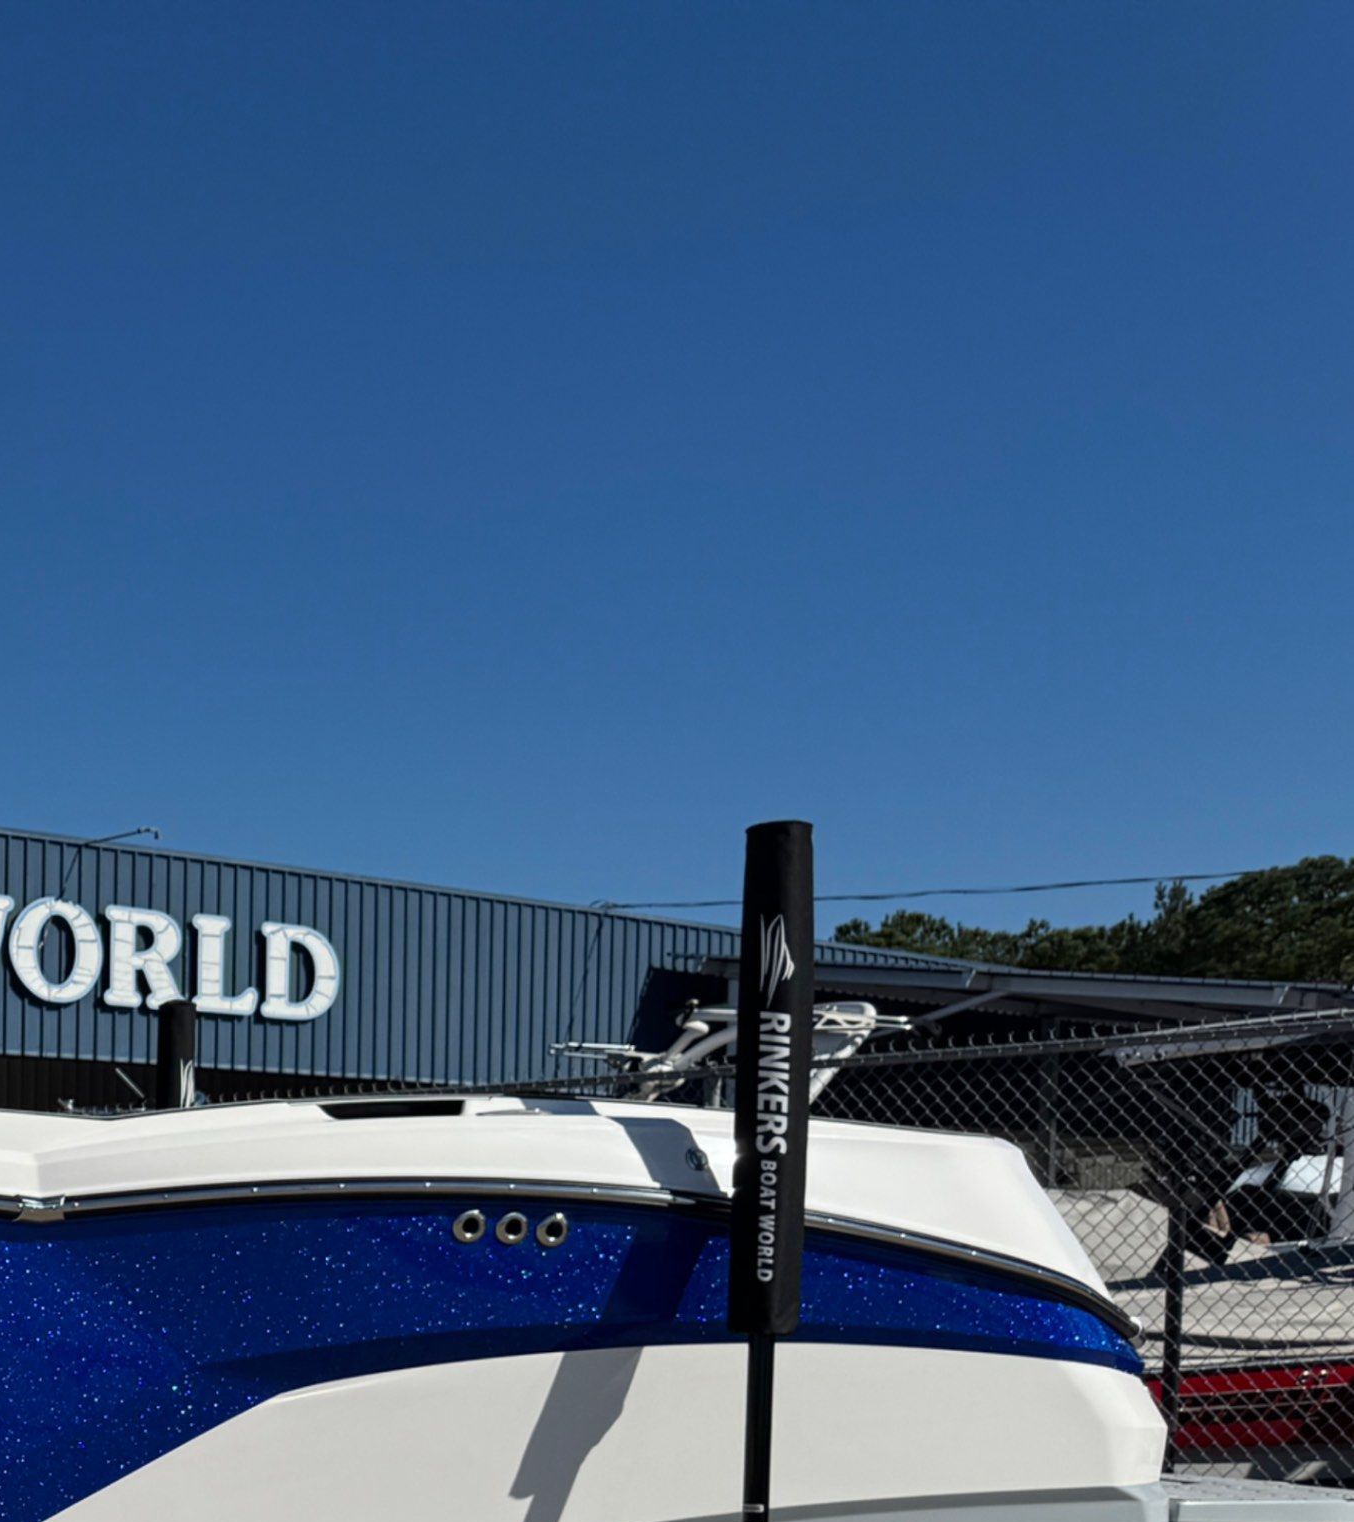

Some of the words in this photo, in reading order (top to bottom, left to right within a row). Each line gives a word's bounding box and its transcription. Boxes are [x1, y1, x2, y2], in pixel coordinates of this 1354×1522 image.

[755, 1010, 792, 1156] RINKERS
[759, 1159, 778, 1209] BOAT
[757, 1214, 776, 1283] WORLD
